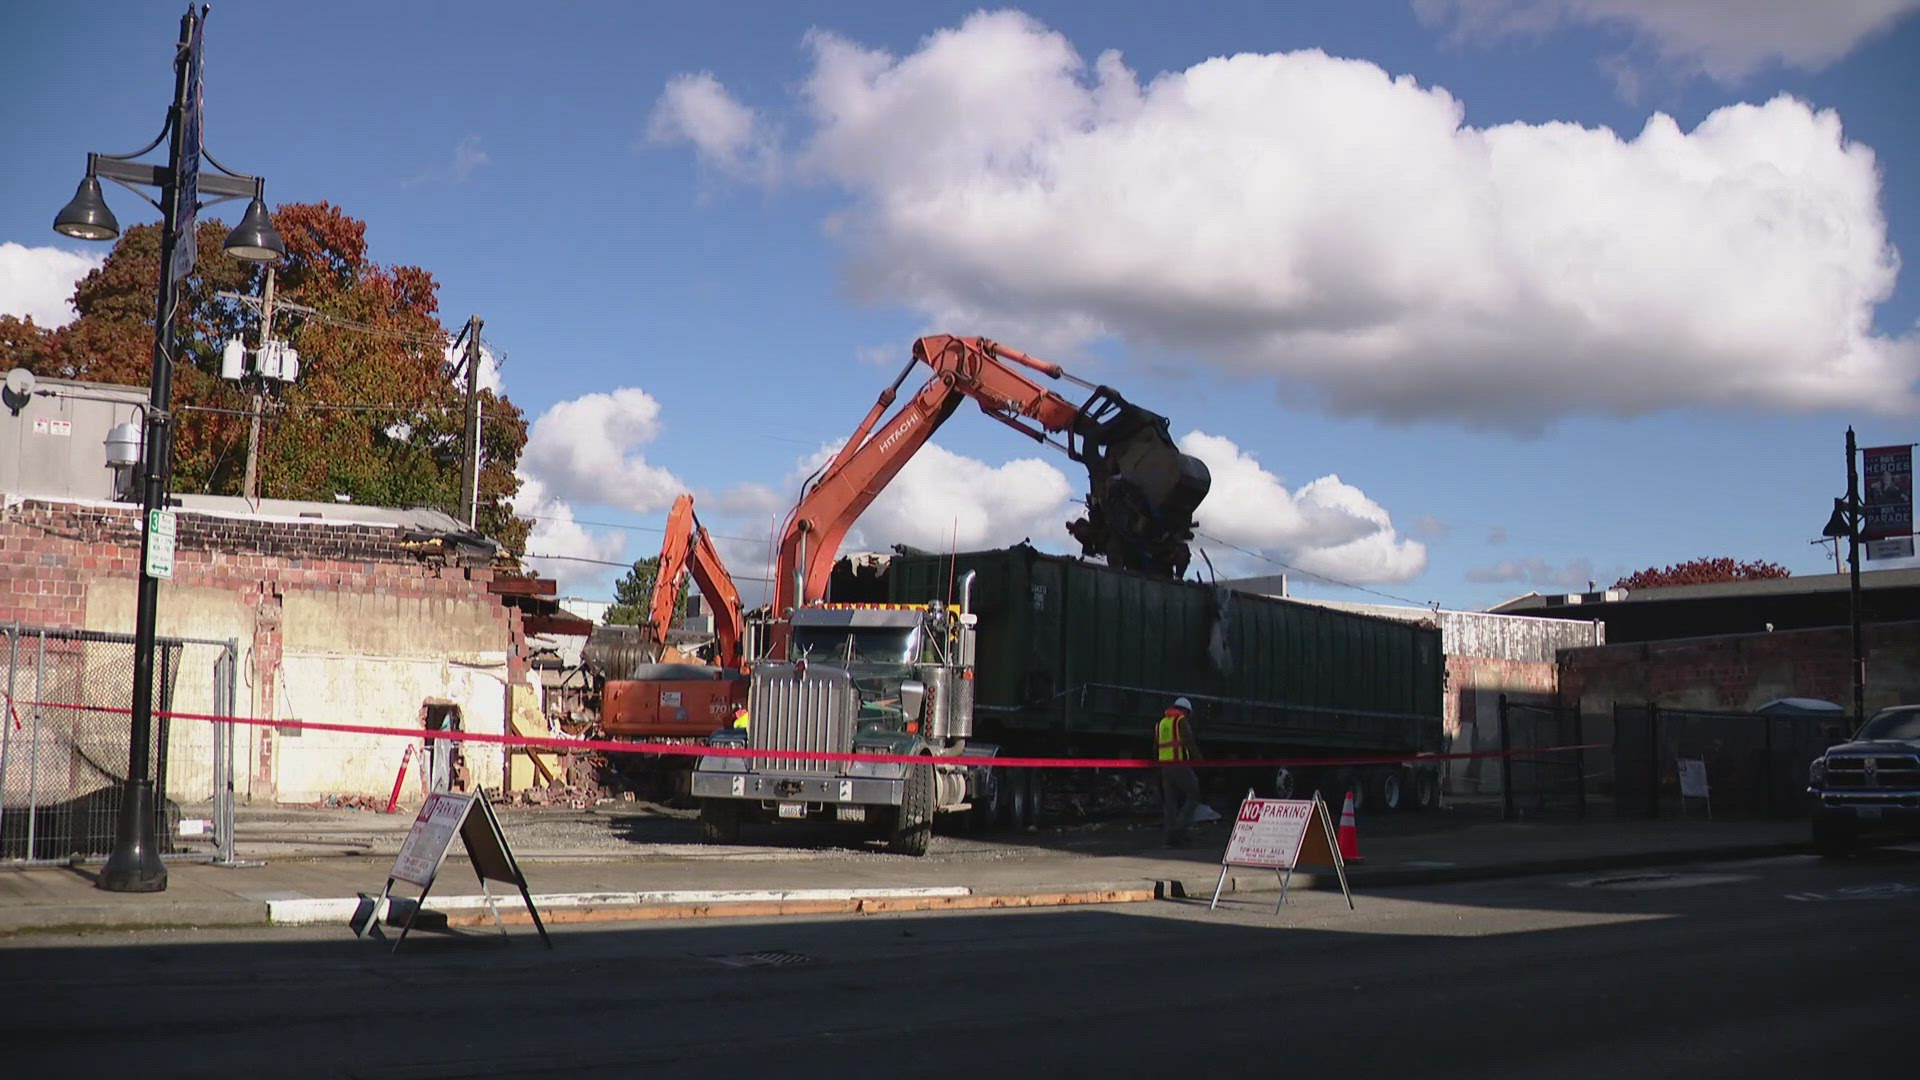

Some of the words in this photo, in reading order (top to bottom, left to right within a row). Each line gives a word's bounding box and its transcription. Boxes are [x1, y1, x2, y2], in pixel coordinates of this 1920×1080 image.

[879, 412, 919, 454] HITACHI
[1865, 462, 1910, 474] HEROES
[152, 513, 158, 531] 3
[1867, 513, 1910, 524] PARADE
[1241, 803, 1261, 820] NO
[1262, 804, 1307, 820] PARKING
[1237, 823, 1254, 831] FROM
